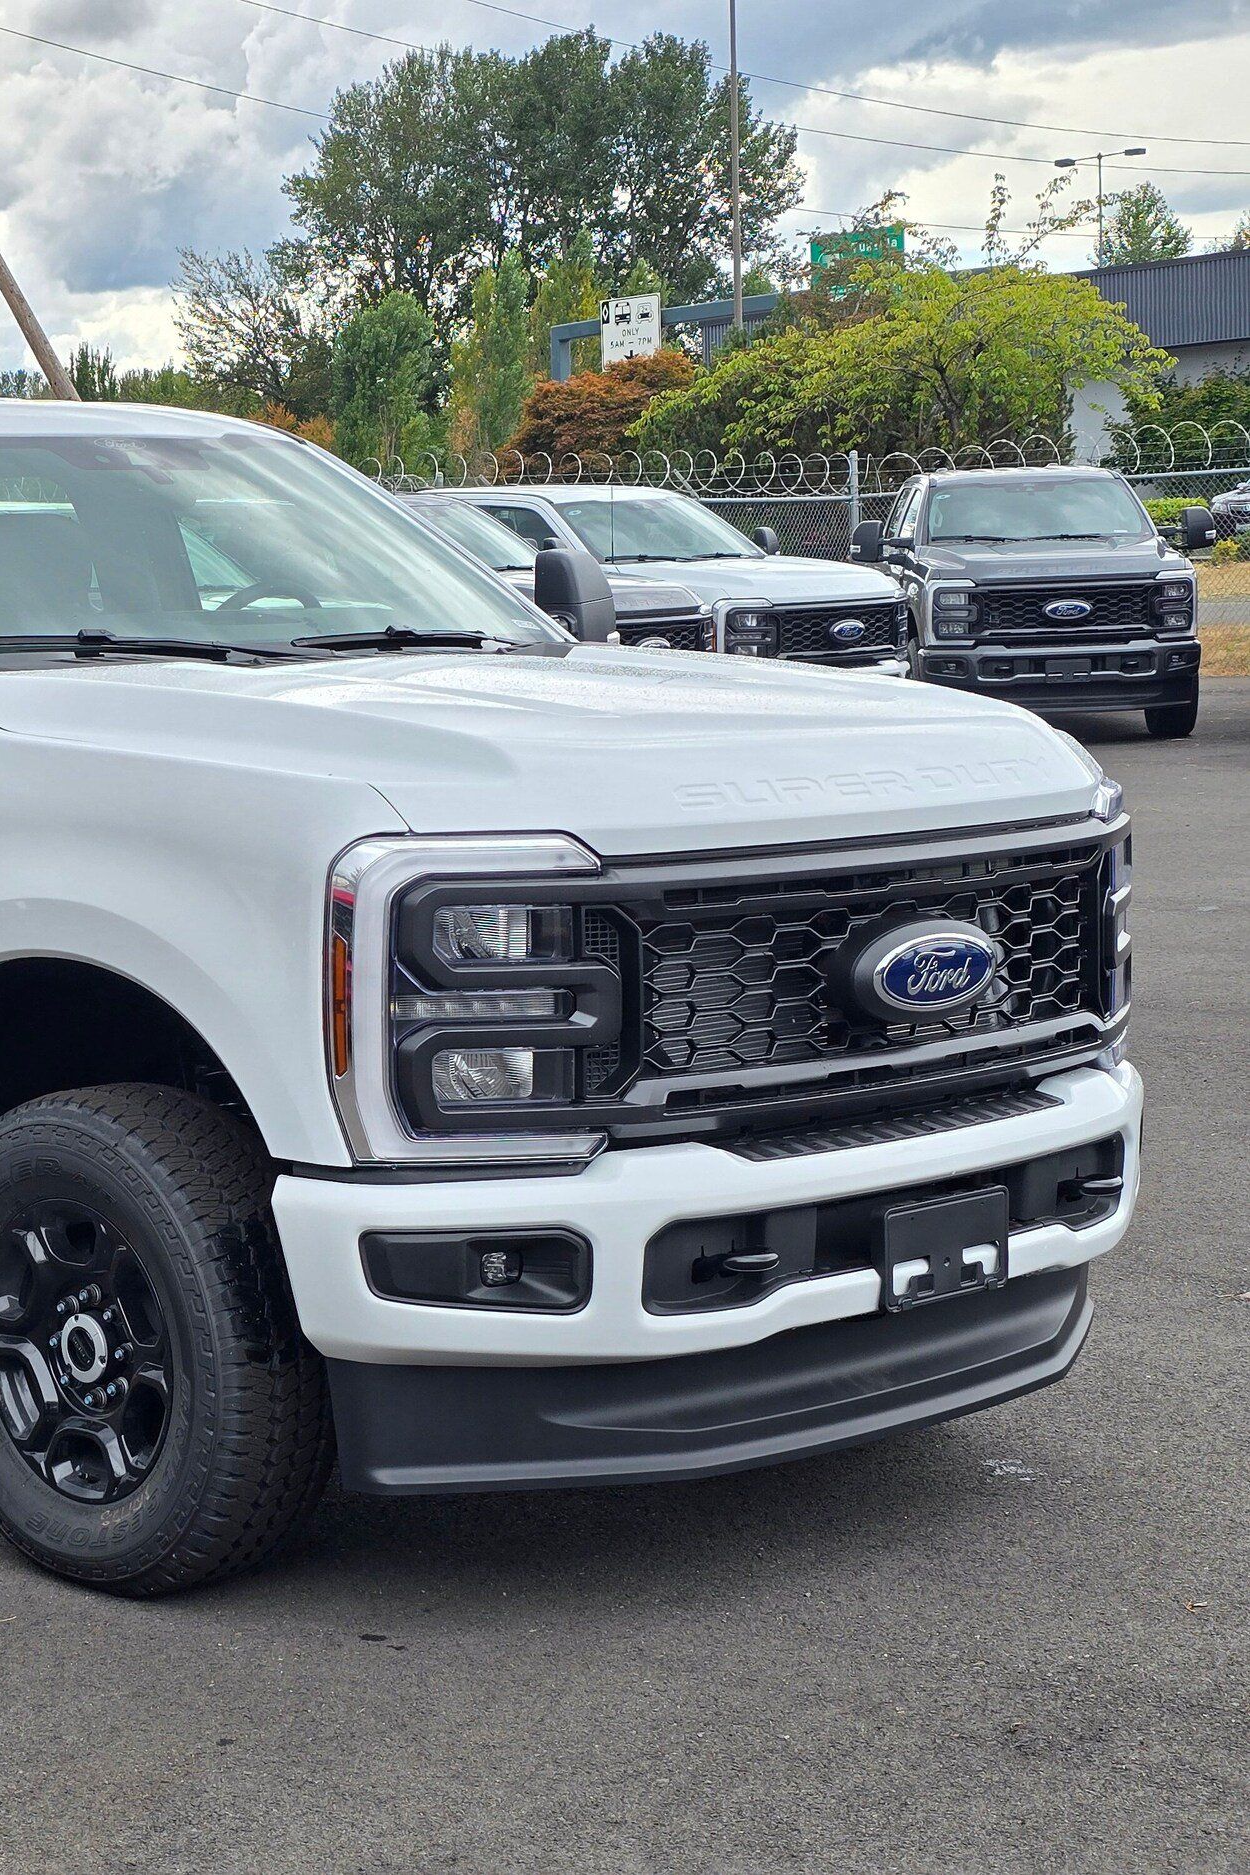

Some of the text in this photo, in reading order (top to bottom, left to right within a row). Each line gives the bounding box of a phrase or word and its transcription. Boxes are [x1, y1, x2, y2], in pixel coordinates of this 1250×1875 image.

[621, 327, 639, 337] ONLY
[610, 340, 625, 349] 5AM
[637, 336, 652, 347] 7PM
[1056, 605, 1081, 616] Ford
[674, 755, 1050, 812] SUPER DUTY
[907, 949, 973, 996] Ford
